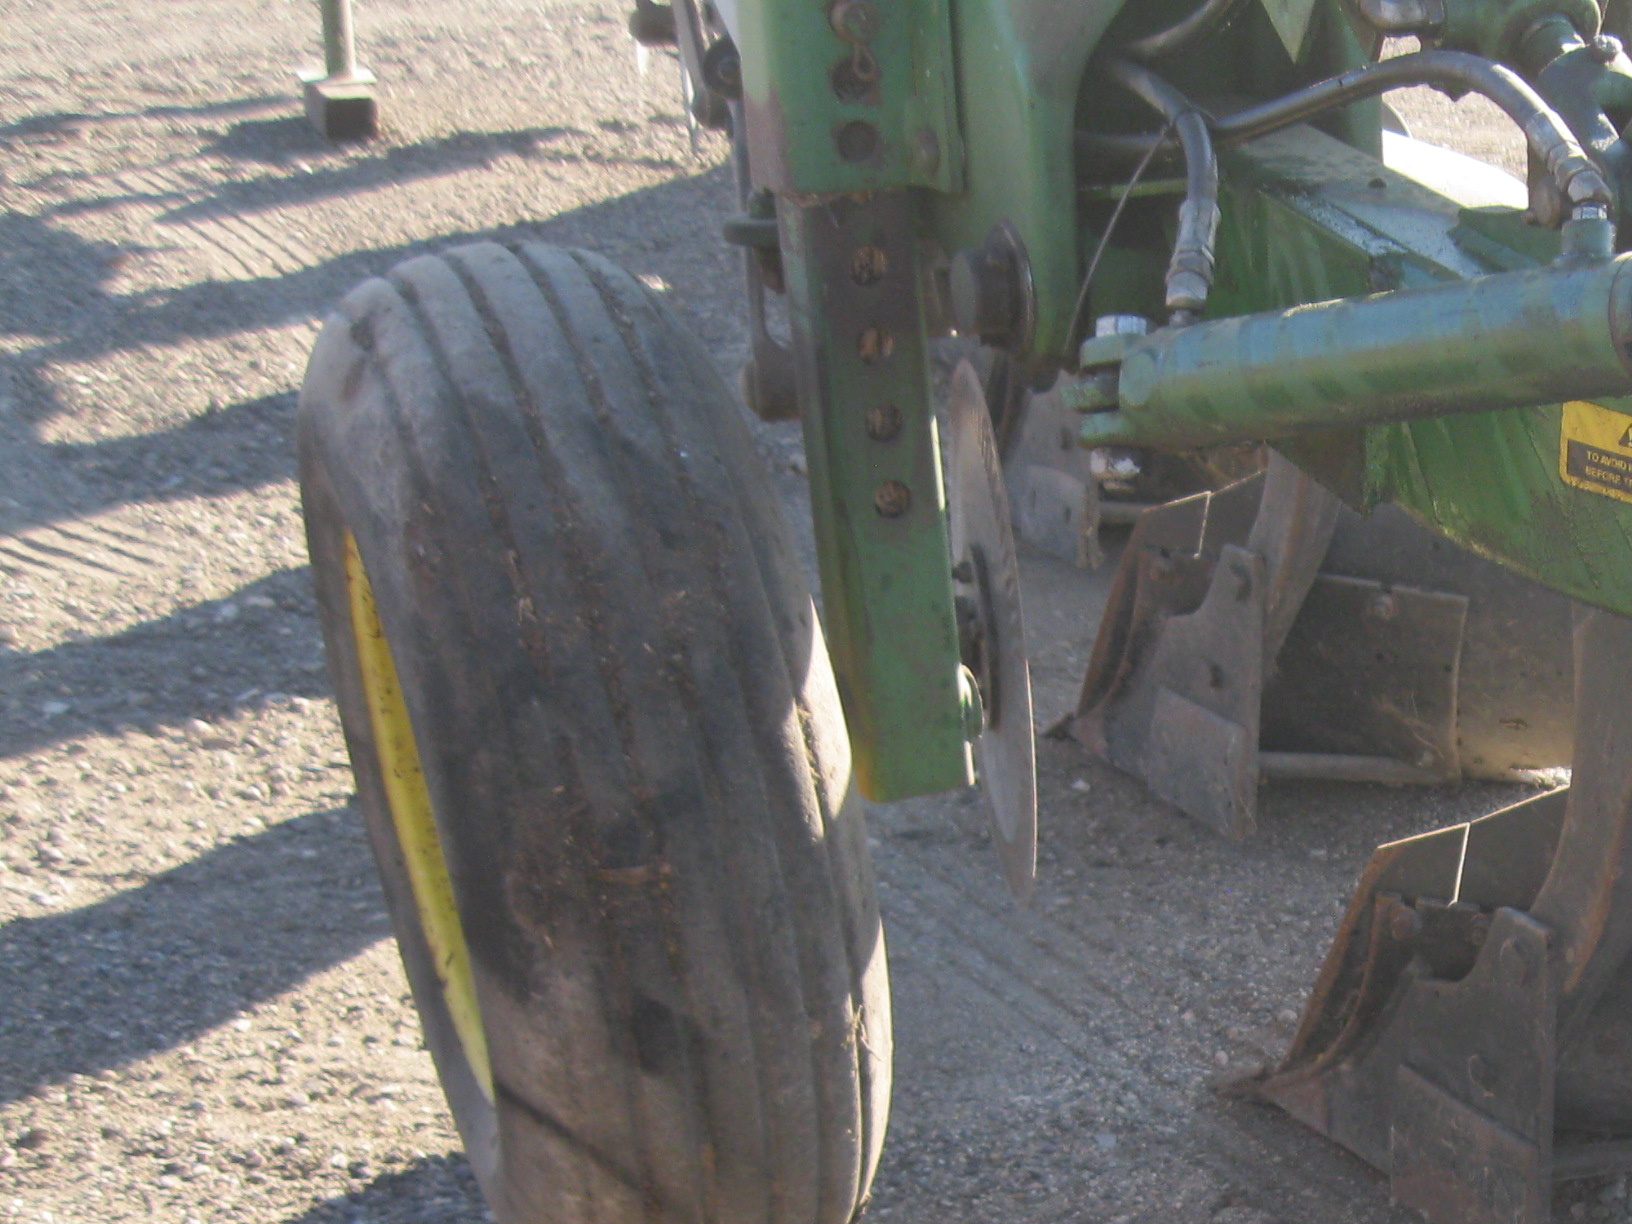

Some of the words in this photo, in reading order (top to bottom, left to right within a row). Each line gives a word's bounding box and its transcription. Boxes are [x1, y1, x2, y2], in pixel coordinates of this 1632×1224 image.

[1586, 450, 1599, 462] TO
[1600, 456, 1627, 470] AVOID
[1585, 466, 1622, 484] BEFORE
